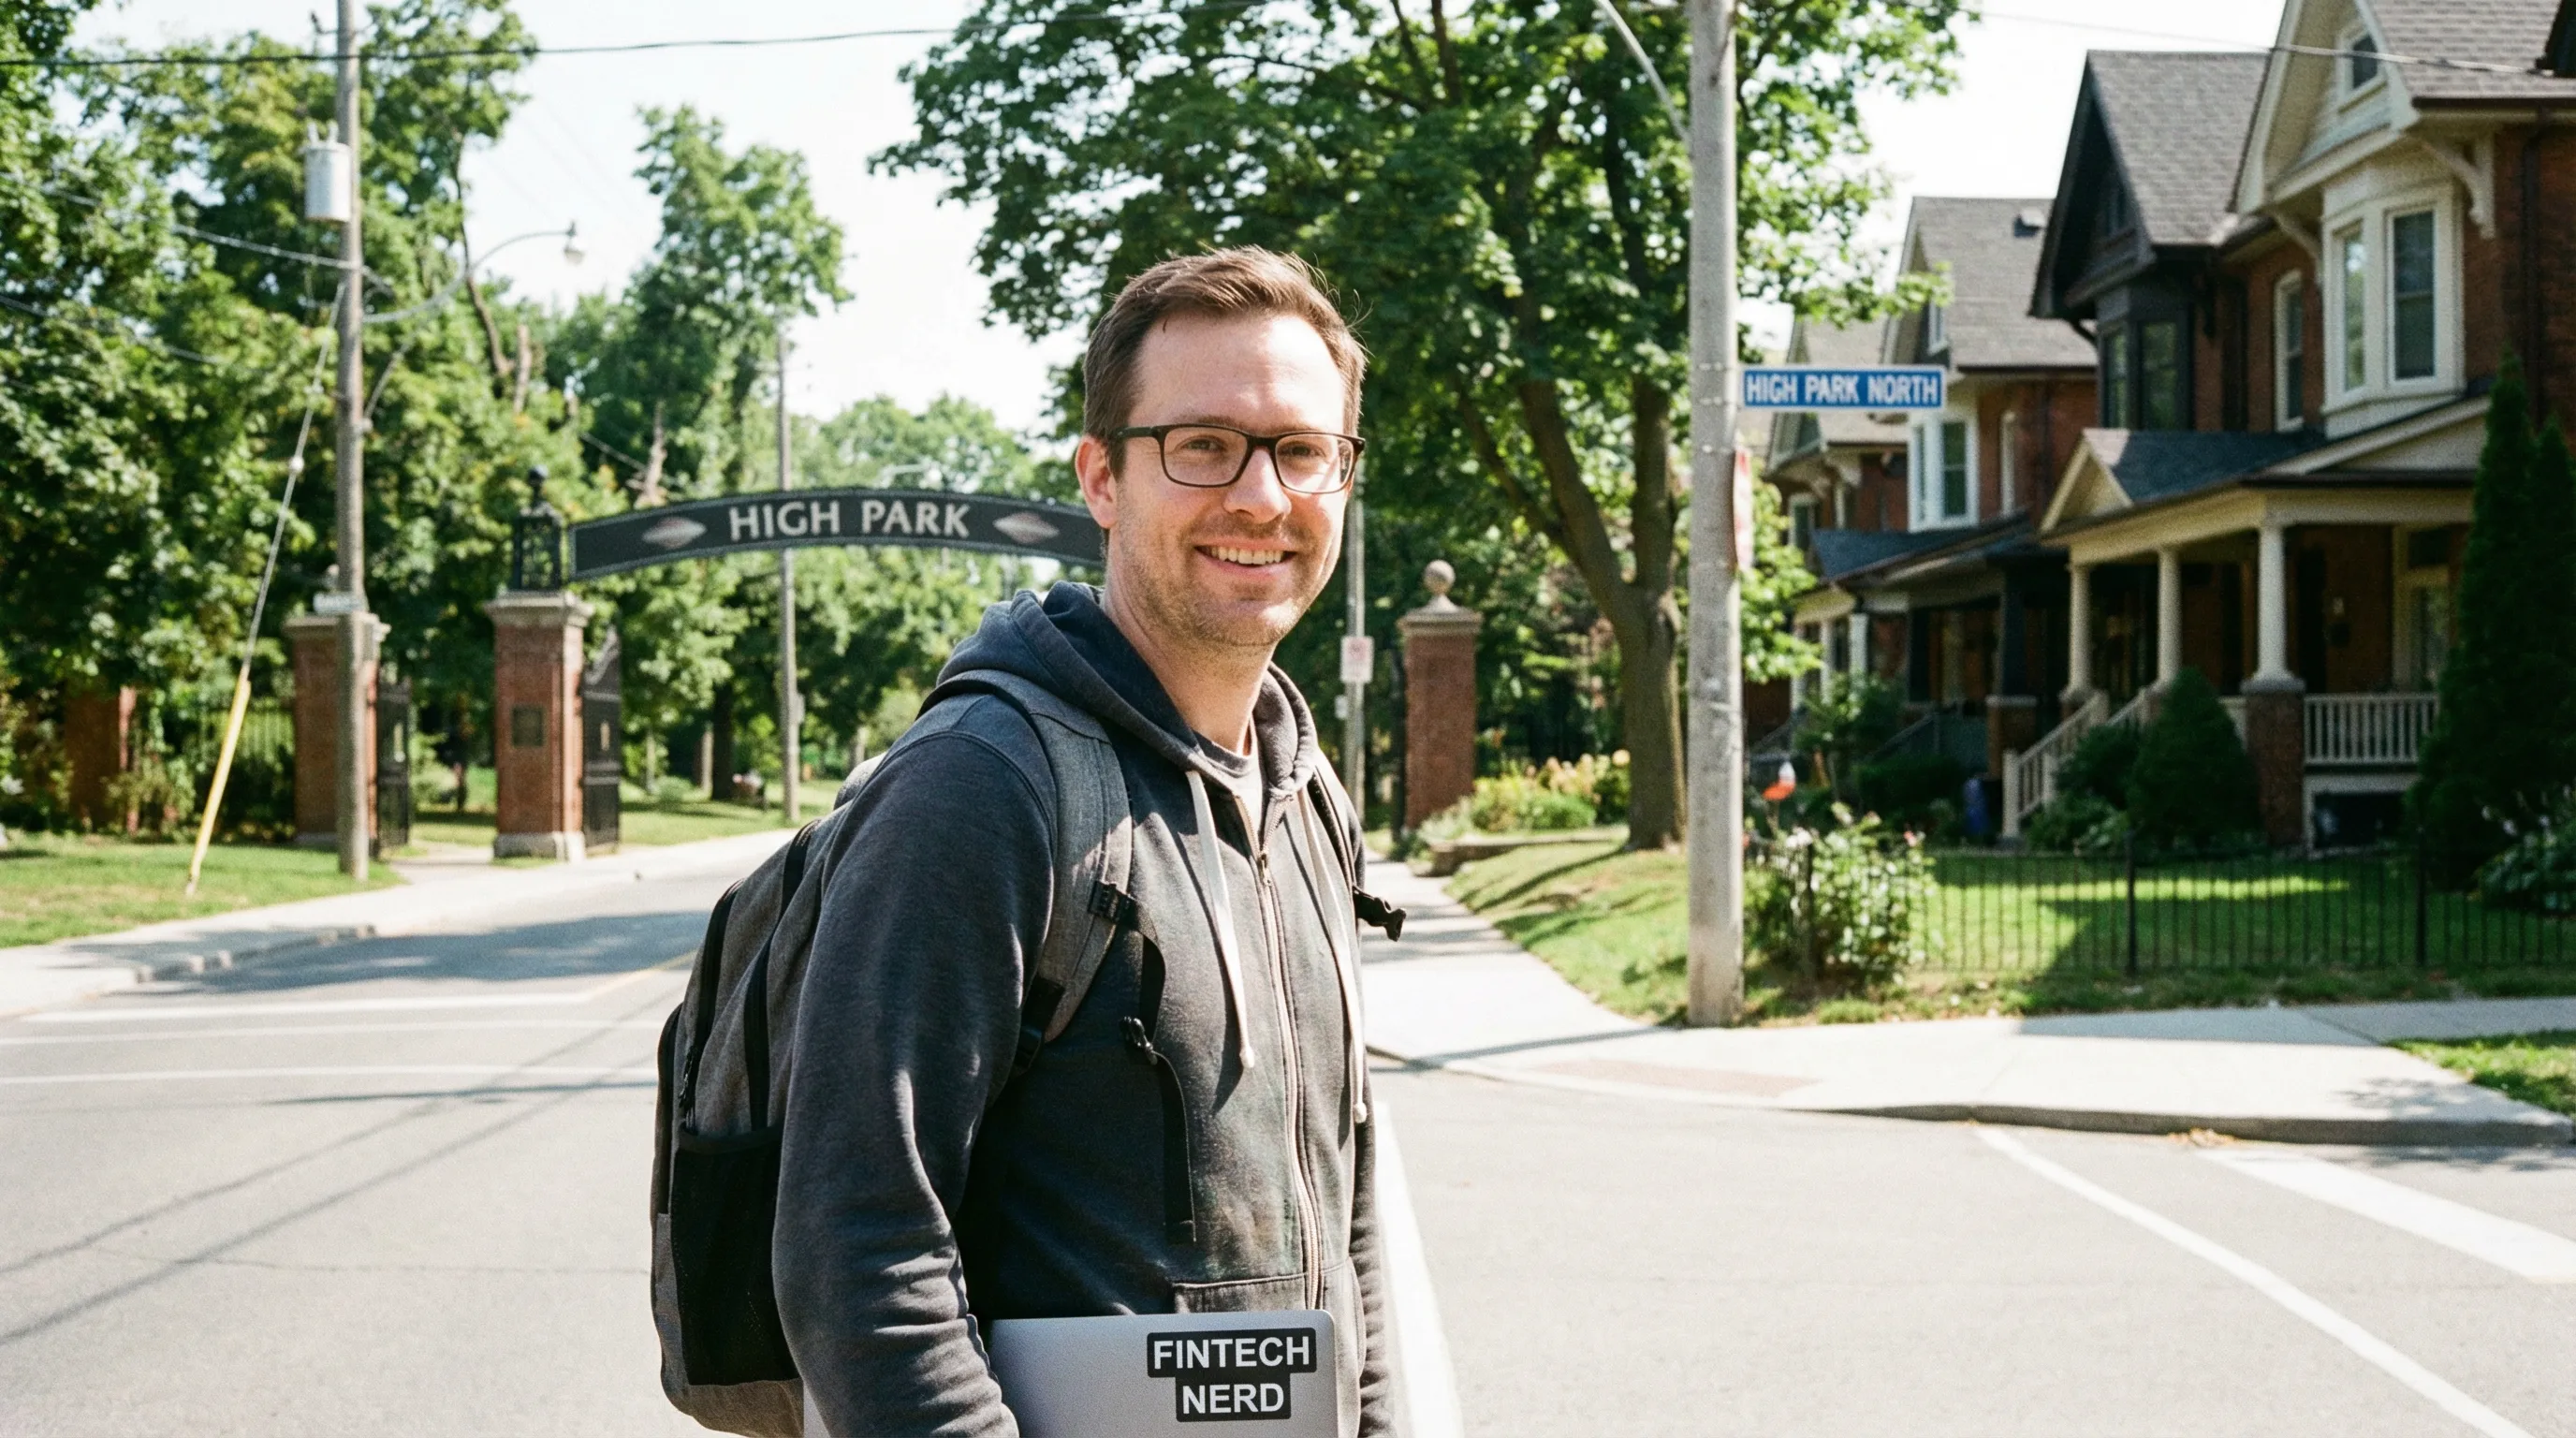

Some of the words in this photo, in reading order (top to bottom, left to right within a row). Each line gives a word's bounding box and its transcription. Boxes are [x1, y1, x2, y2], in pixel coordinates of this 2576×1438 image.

[1747, 374, 1798, 404] HIGH
[1805, 374, 1860, 404] PARK
[1867, 374, 1939, 404] NORTH
[728, 500, 840, 541] HIGH
[861, 499, 971, 538] PARK
[1153, 1335, 1310, 1370] FINTECH
[1182, 1383, 1285, 1415] NERD
